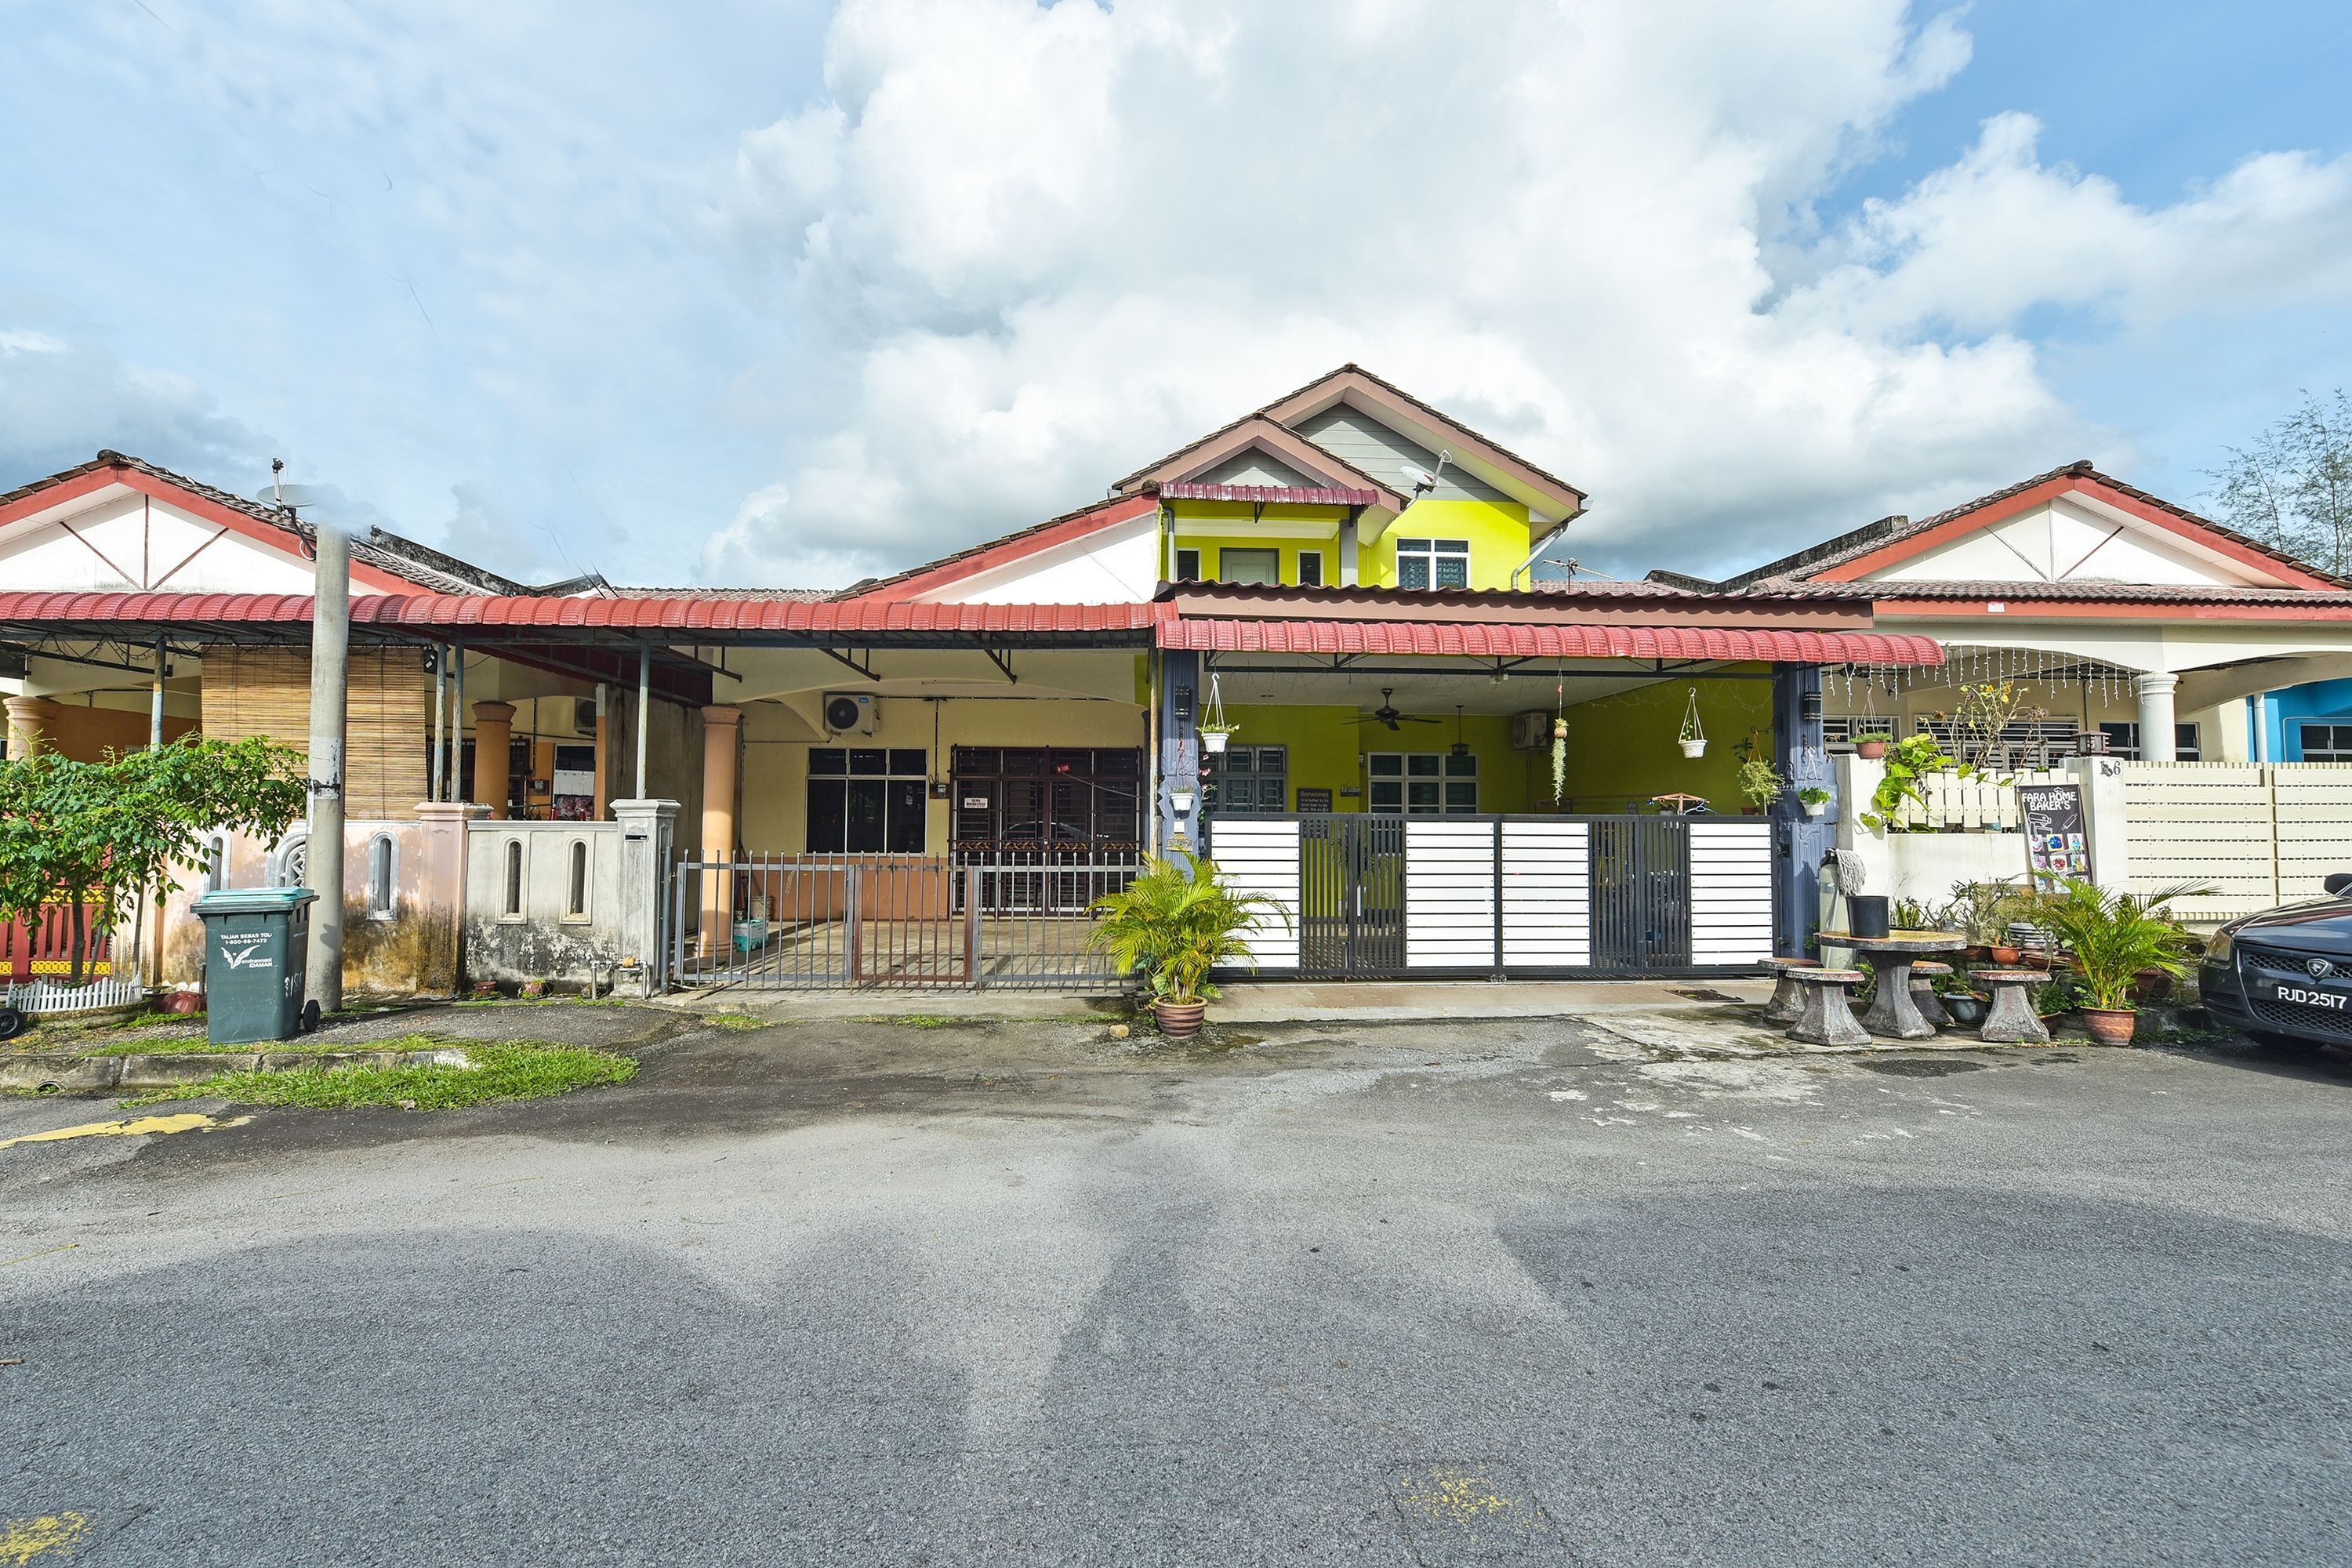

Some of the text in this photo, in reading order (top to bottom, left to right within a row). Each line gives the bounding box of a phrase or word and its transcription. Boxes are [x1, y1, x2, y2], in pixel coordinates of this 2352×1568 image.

[2022, 791, 2077, 802] FARA HOME
[2030, 800, 2071, 811] BAKER'S
[2307, 991, 2347, 1010] 2517
